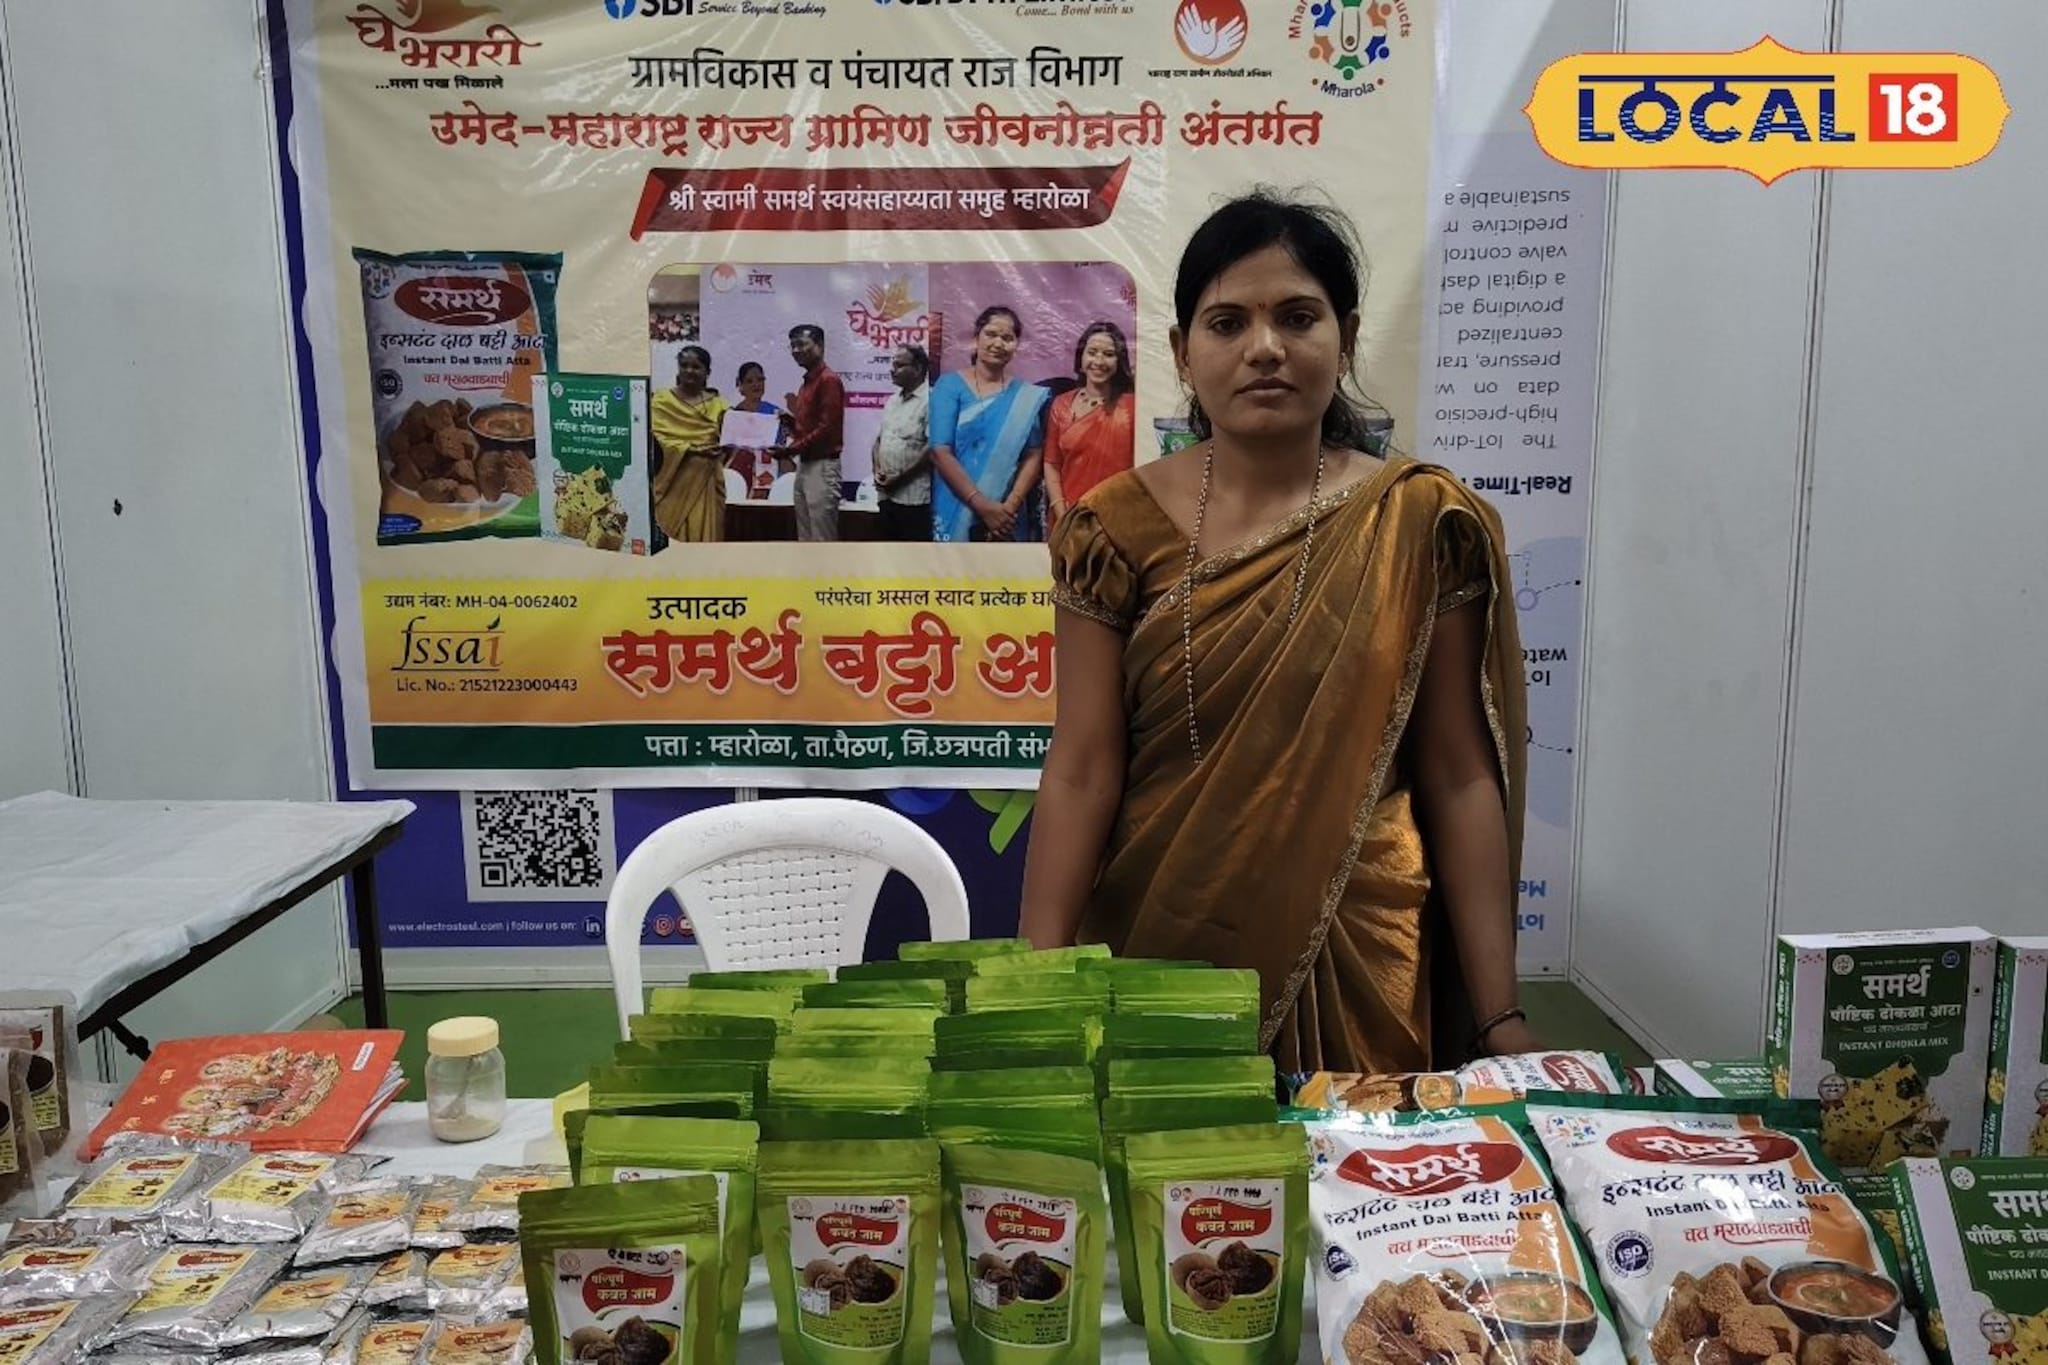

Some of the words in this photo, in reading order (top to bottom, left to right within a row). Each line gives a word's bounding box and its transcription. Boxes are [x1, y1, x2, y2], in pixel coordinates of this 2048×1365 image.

[698, 1, 737, 14] Service
[742, 1, 779, 18] Beyond
[784, 1, 826, 18] Banking
[1121, 6, 1134, 15] us
[399, 24, 542, 68] भरारी
[628, 47, 799, 89] ग्रामविकास
[806, 59, 833, 89] व
[840, 49, 953, 89] पंचायत
[961, 57, 1018, 88] राज
[1026, 46, 1123, 88] विभाग
[1320, 80, 1376, 98] Mharola
[697, 113, 794, 149] राज्य
[805, 104, 931, 151] ग्रामिण
[944, 100, 1165, 150] जीवनोन्नती
[1180, 99, 1323, 146] अंतर्गत
[668, 184, 694, 211] श्री
[700, 184, 756, 211] स्वामी
[763, 184, 816, 211] समर्थ
[958, 187, 1007, 218] समुह
[1010, 182, 1090, 211] म्हारोळा
[1460, 190, 1571, 209] sustainable
[1472, 214, 1568, 236] predictive
[1444, 246, 1511, 264] control
[1518, 245, 1568, 262] valve
[1487, 270, 1548, 291] digital
[1555, 272, 1566, 285] a
[416, 279, 501, 311] समर्थ
[1472, 296, 1564, 319] providing
[441, 332, 473, 350] दाल
[1458, 327, 1563, 345] centralized
[404, 354, 446, 365] Instant
[450, 354, 470, 365] Dal
[1475, 351, 1561, 368] pressure,
[1473, 381, 1498, 394] on
[1518, 381, 1560, 396] data
[568, 396, 608, 419] समर्थ
[1435, 404, 1558, 424] high-precisio
[1433, 433, 1503, 451] IoT-driv
[1521, 434, 1557, 449] The
[1473, 475, 1573, 495] Real-Time
[455, 594, 578, 609] MH-04-0062402
[815, 586, 872, 606] परंपरेचा
[876, 588, 929, 606] अस्सल
[934, 588, 975, 606] स्वाद
[979, 586, 1027, 606] प्रत्येक
[646, 597, 748, 621] उत्पादक
[393, 615, 505, 671] fssai
[602, 609, 803, 697] समर्थ
[820, 611, 961, 718] बट्टी
[396, 678, 422, 692] Lic.
[425, 678, 456, 692] No.:
[459, 678, 578, 692] 21521223000443
[644, 733, 688, 757] पत्ता
[901, 728, 1014, 758] जि.छत्रपती
[511, 919, 544, 931] follow
[546, 922, 559, 931] us
[560, 921, 577, 931] on:
[1861, 963, 1932, 999] समर्थ
[1829, 1003, 1875, 1022] पौष्टिक
[1879, 1002, 1925, 1021] ढोकळा
[1930, 1003, 1961, 1018] आटा
[1839, 1041, 1882, 1052] INSTANT
[1884, 1039, 1927, 1049] DHOKLA
[1929, 1037, 1949, 1047] MIX
[1637, 1136, 1760, 1158] समर्थ
[1362, 1143, 1483, 1190] समर्थ
[1645, 1199, 1711, 1217] Instant
[1356, 1218, 1417, 1241] Instant
[1423, 1214, 1451, 1226] Dal
[1459, 1211, 1500, 1223] Batti
[1507, 1210, 1543, 1221] Atta
[1965, 1224, 2017, 1245] पौष्टिक
[1987, 1269, 2038, 1280] INSTANT
